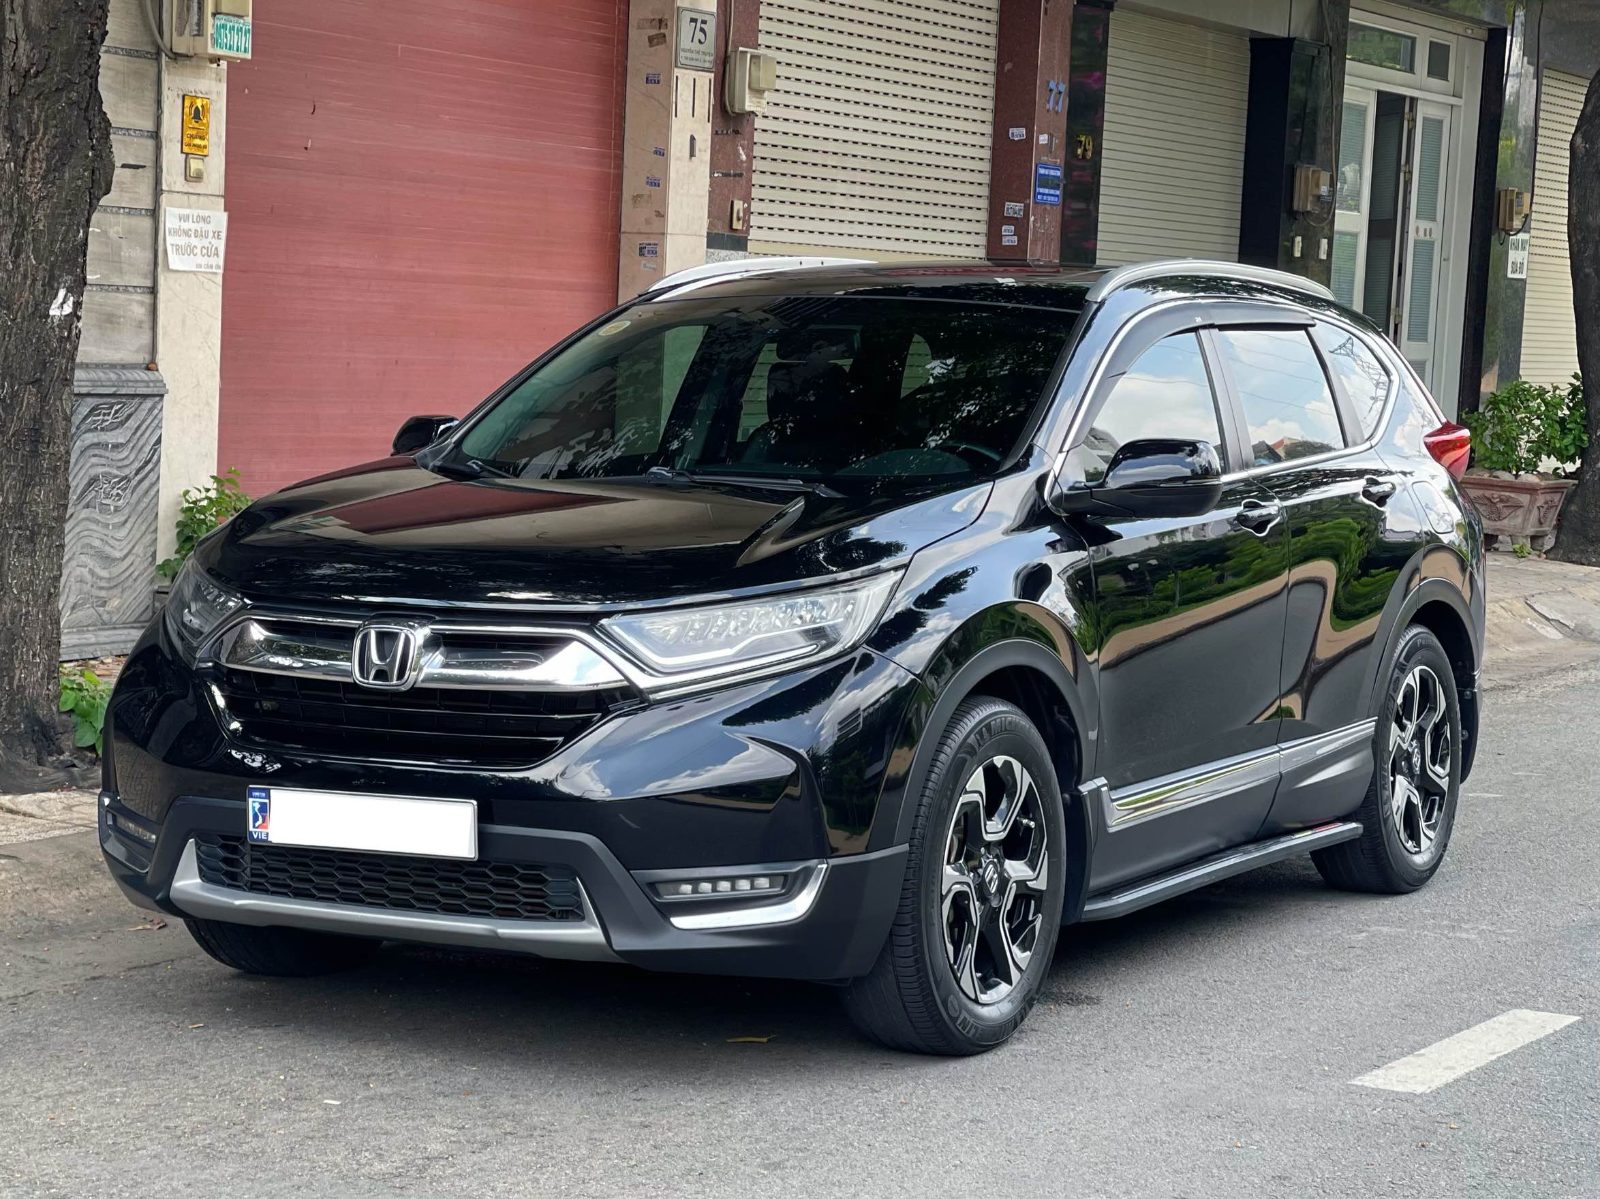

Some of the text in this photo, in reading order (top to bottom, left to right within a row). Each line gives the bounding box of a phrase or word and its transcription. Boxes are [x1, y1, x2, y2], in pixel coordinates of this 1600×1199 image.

[689, 17, 708, 45] 75
[1046, 79, 1065, 113] 77
[1075, 134, 1093, 160] 79
[178, 213, 190, 223] VUI
[167, 226, 223, 240] KHÔNG ĐẬU XE
[170, 241, 220, 258] TRƯỚC CỬA
[252, 831, 268, 840] VIE
